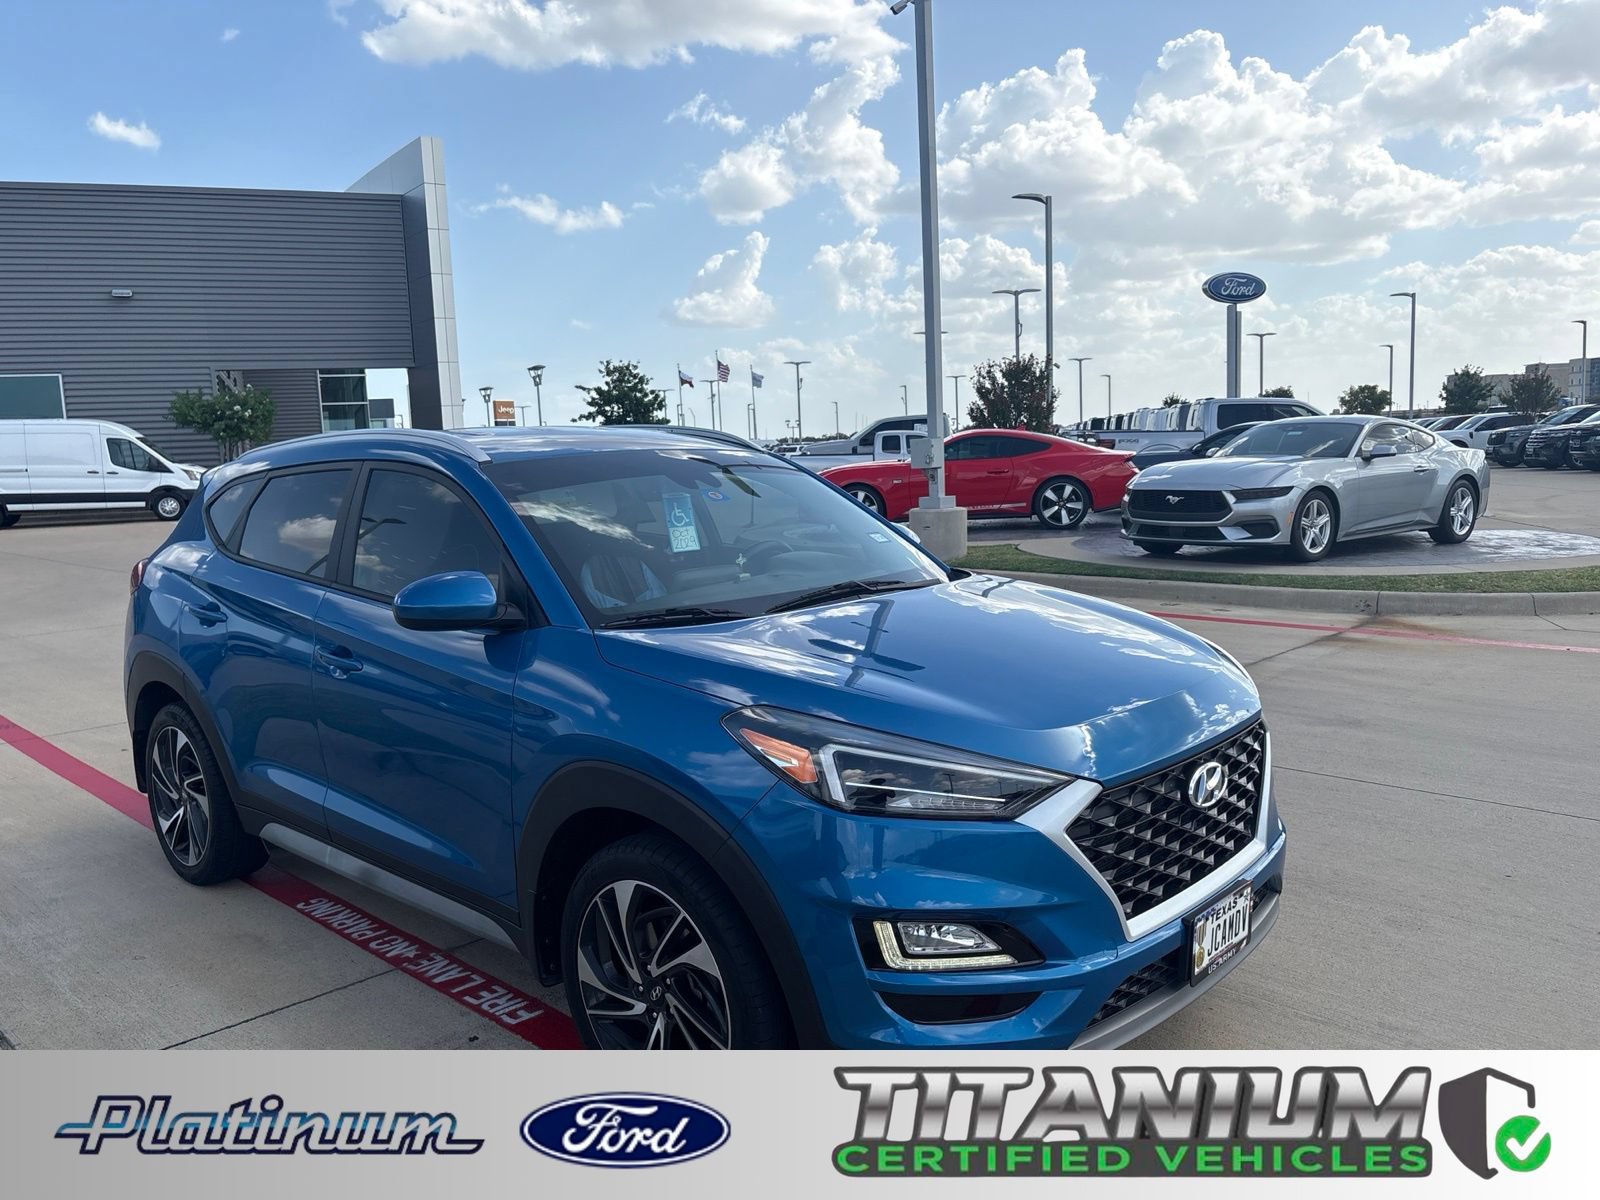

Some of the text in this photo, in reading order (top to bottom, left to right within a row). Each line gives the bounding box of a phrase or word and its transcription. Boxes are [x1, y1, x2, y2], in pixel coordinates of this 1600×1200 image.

[1222, 278, 1255, 295] Ford
[499, 405, 514, 414] Jeep
[296, 898, 383, 942] PARKING
[1211, 898, 1238, 923] TEXAS
[464, 984, 544, 1025] FIRE
